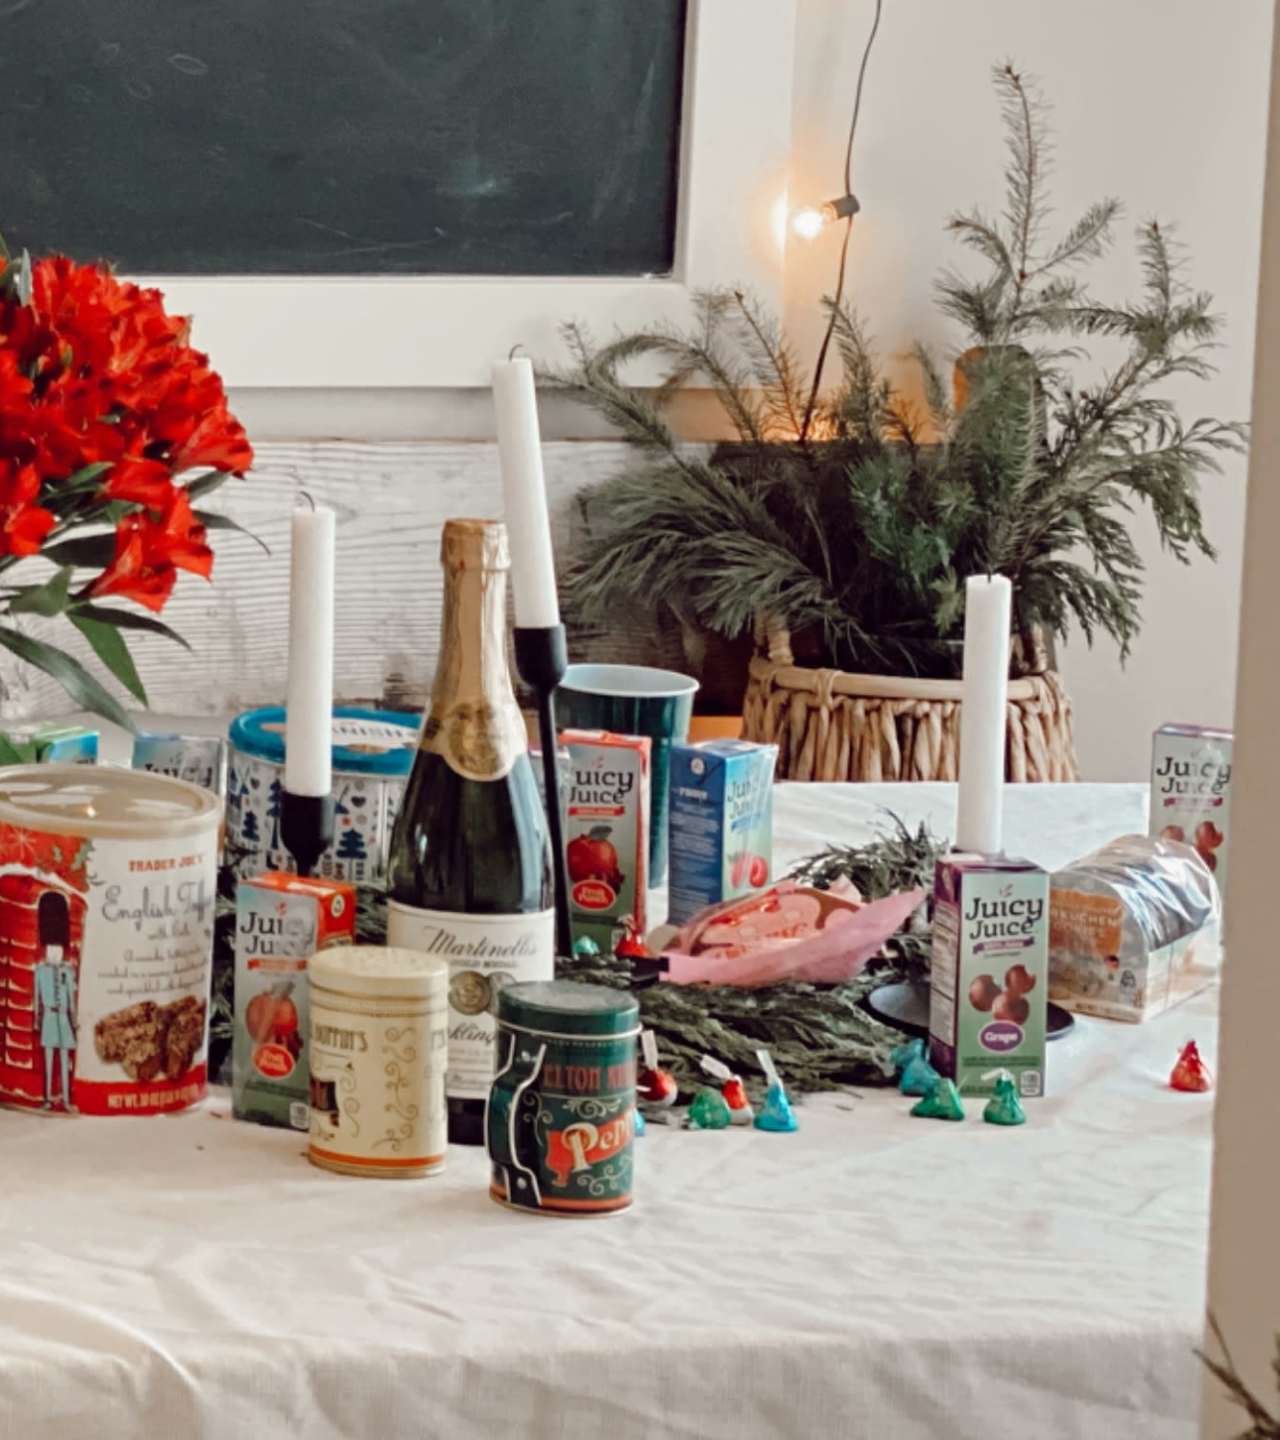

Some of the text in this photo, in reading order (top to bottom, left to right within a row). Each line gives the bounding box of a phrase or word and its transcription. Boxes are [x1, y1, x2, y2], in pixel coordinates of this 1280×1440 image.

[575, 769, 634, 795] uicy
[1156, 756, 1232, 785] Juicy
[1161, 776, 1226, 796] Juice
[127, 859, 176, 872] TRADER
[101, 884, 175, 932] English
[965, 897, 1044, 922] Juicy
[970, 919, 1034, 940] Juice
[448, 1021, 496, 1044] kling
[983, 1030, 1020, 1047] Grape
